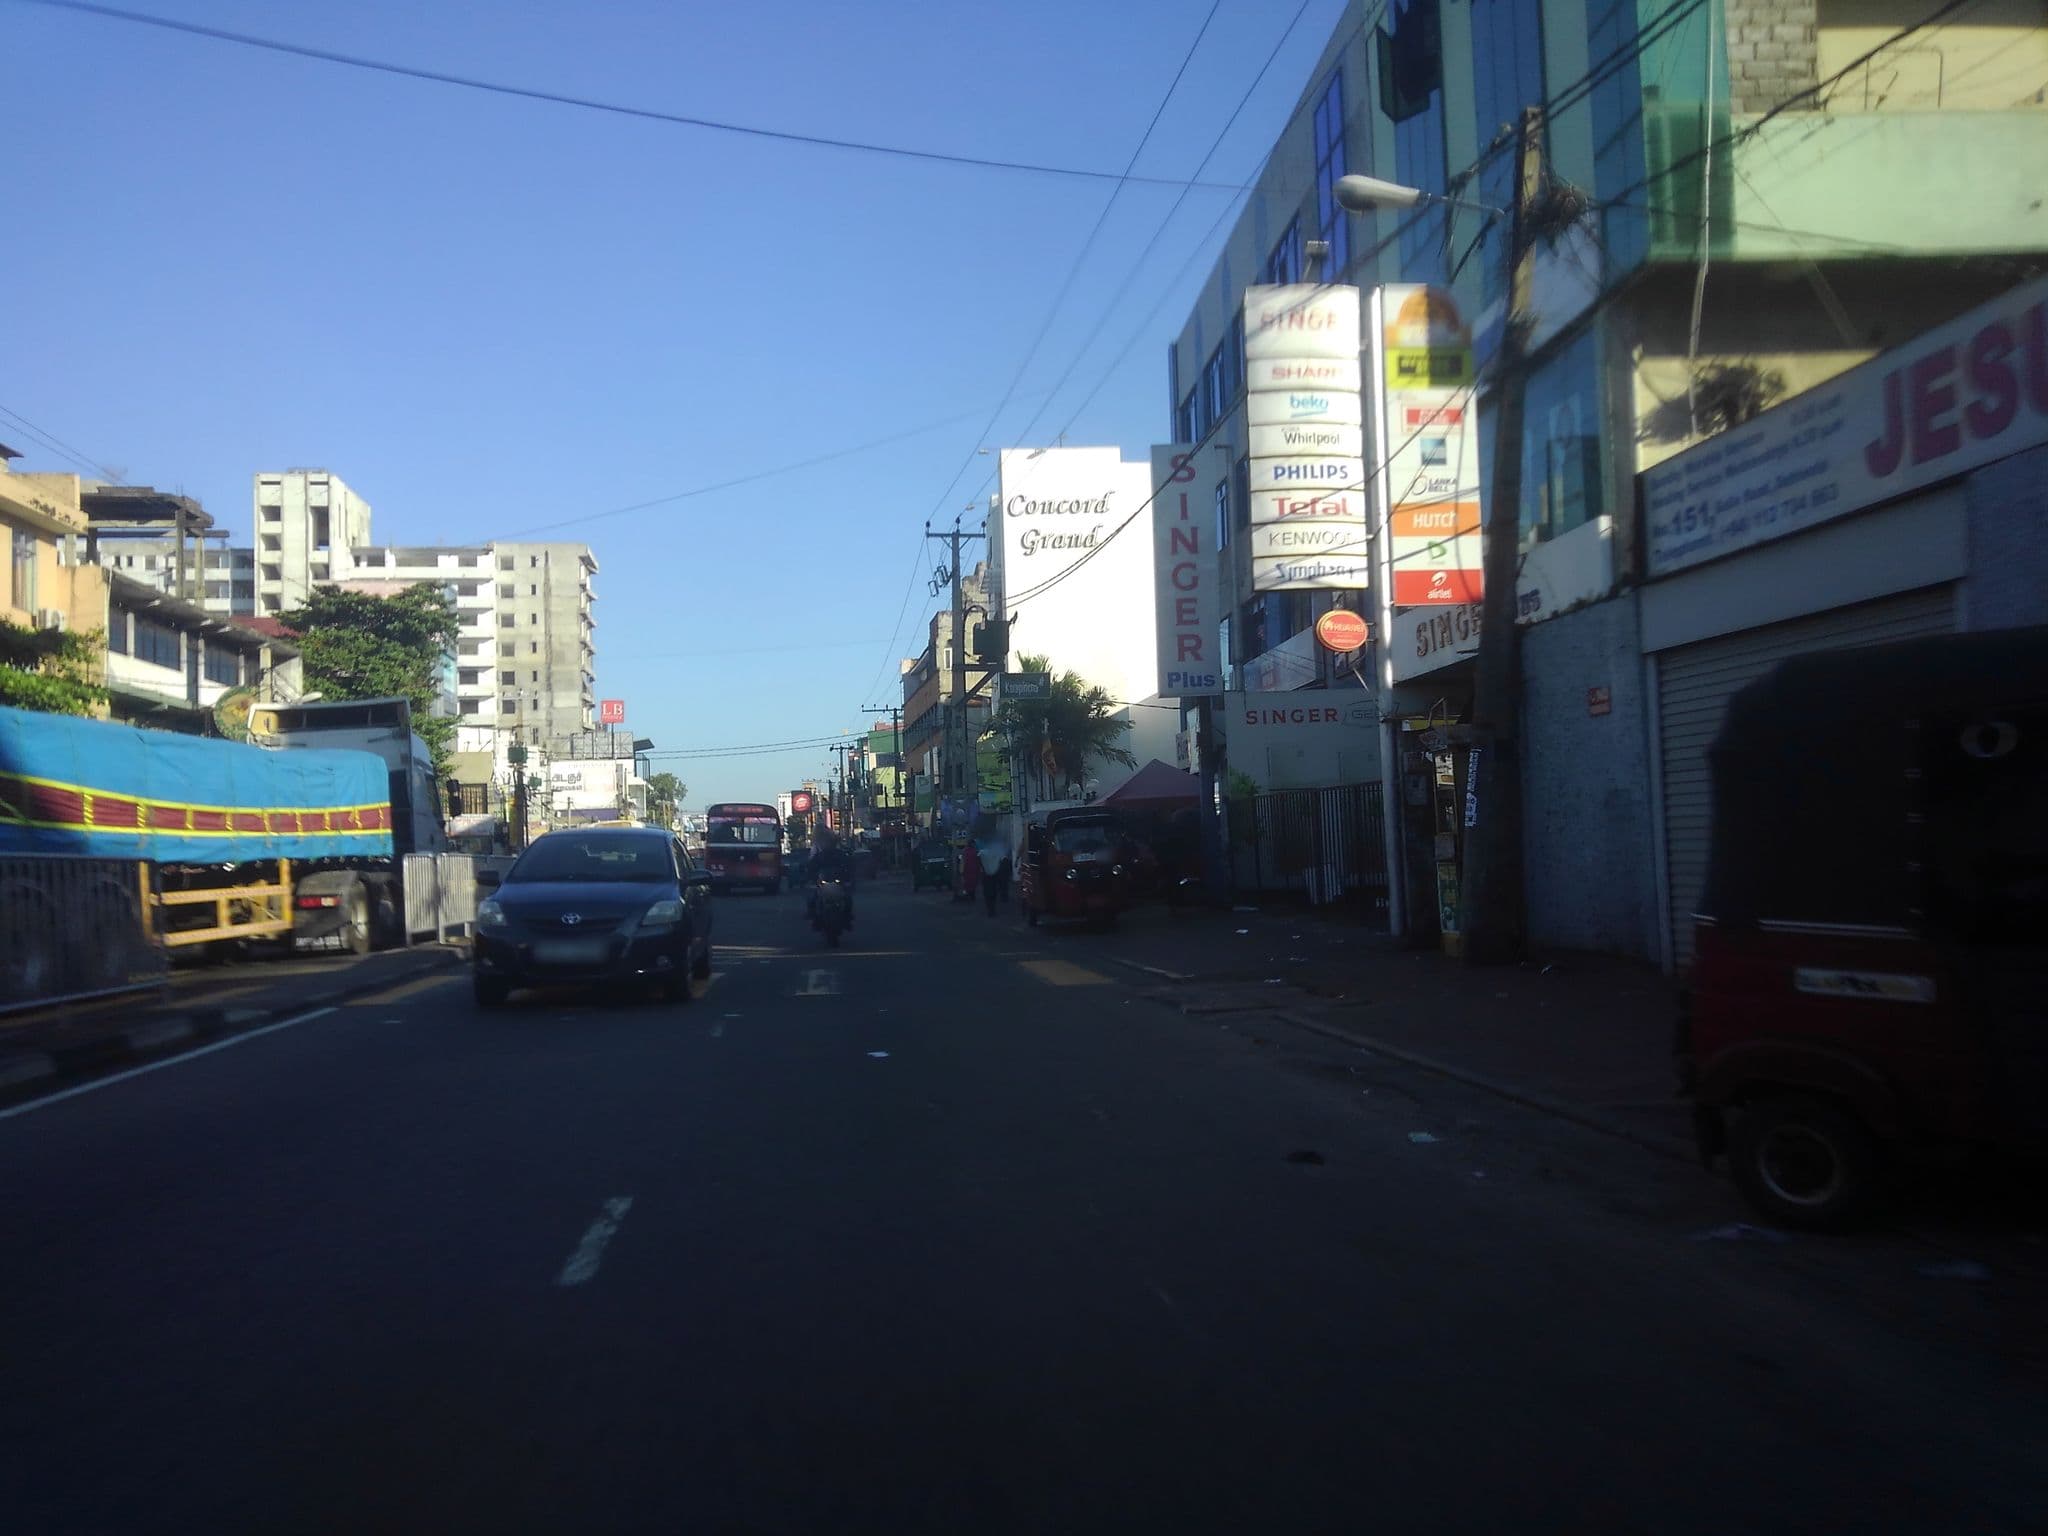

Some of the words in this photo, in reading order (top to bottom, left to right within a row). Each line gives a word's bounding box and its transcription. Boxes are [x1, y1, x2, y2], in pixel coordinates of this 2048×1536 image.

[1289, 394, 1329, 410] beko
[1284, 432, 1340, 446] Whirlpool
[1273, 464, 1349, 480] PHILIPS
[1007, 491, 1115, 518] Concord
[1271, 496, 1352, 517] Tefal
[1020, 525, 1103, 557] Grand
[1169, 453, 1205, 663] SINGER
[1166, 671, 1216, 689] Plus
[1245, 707, 1338, 726] SINGER
